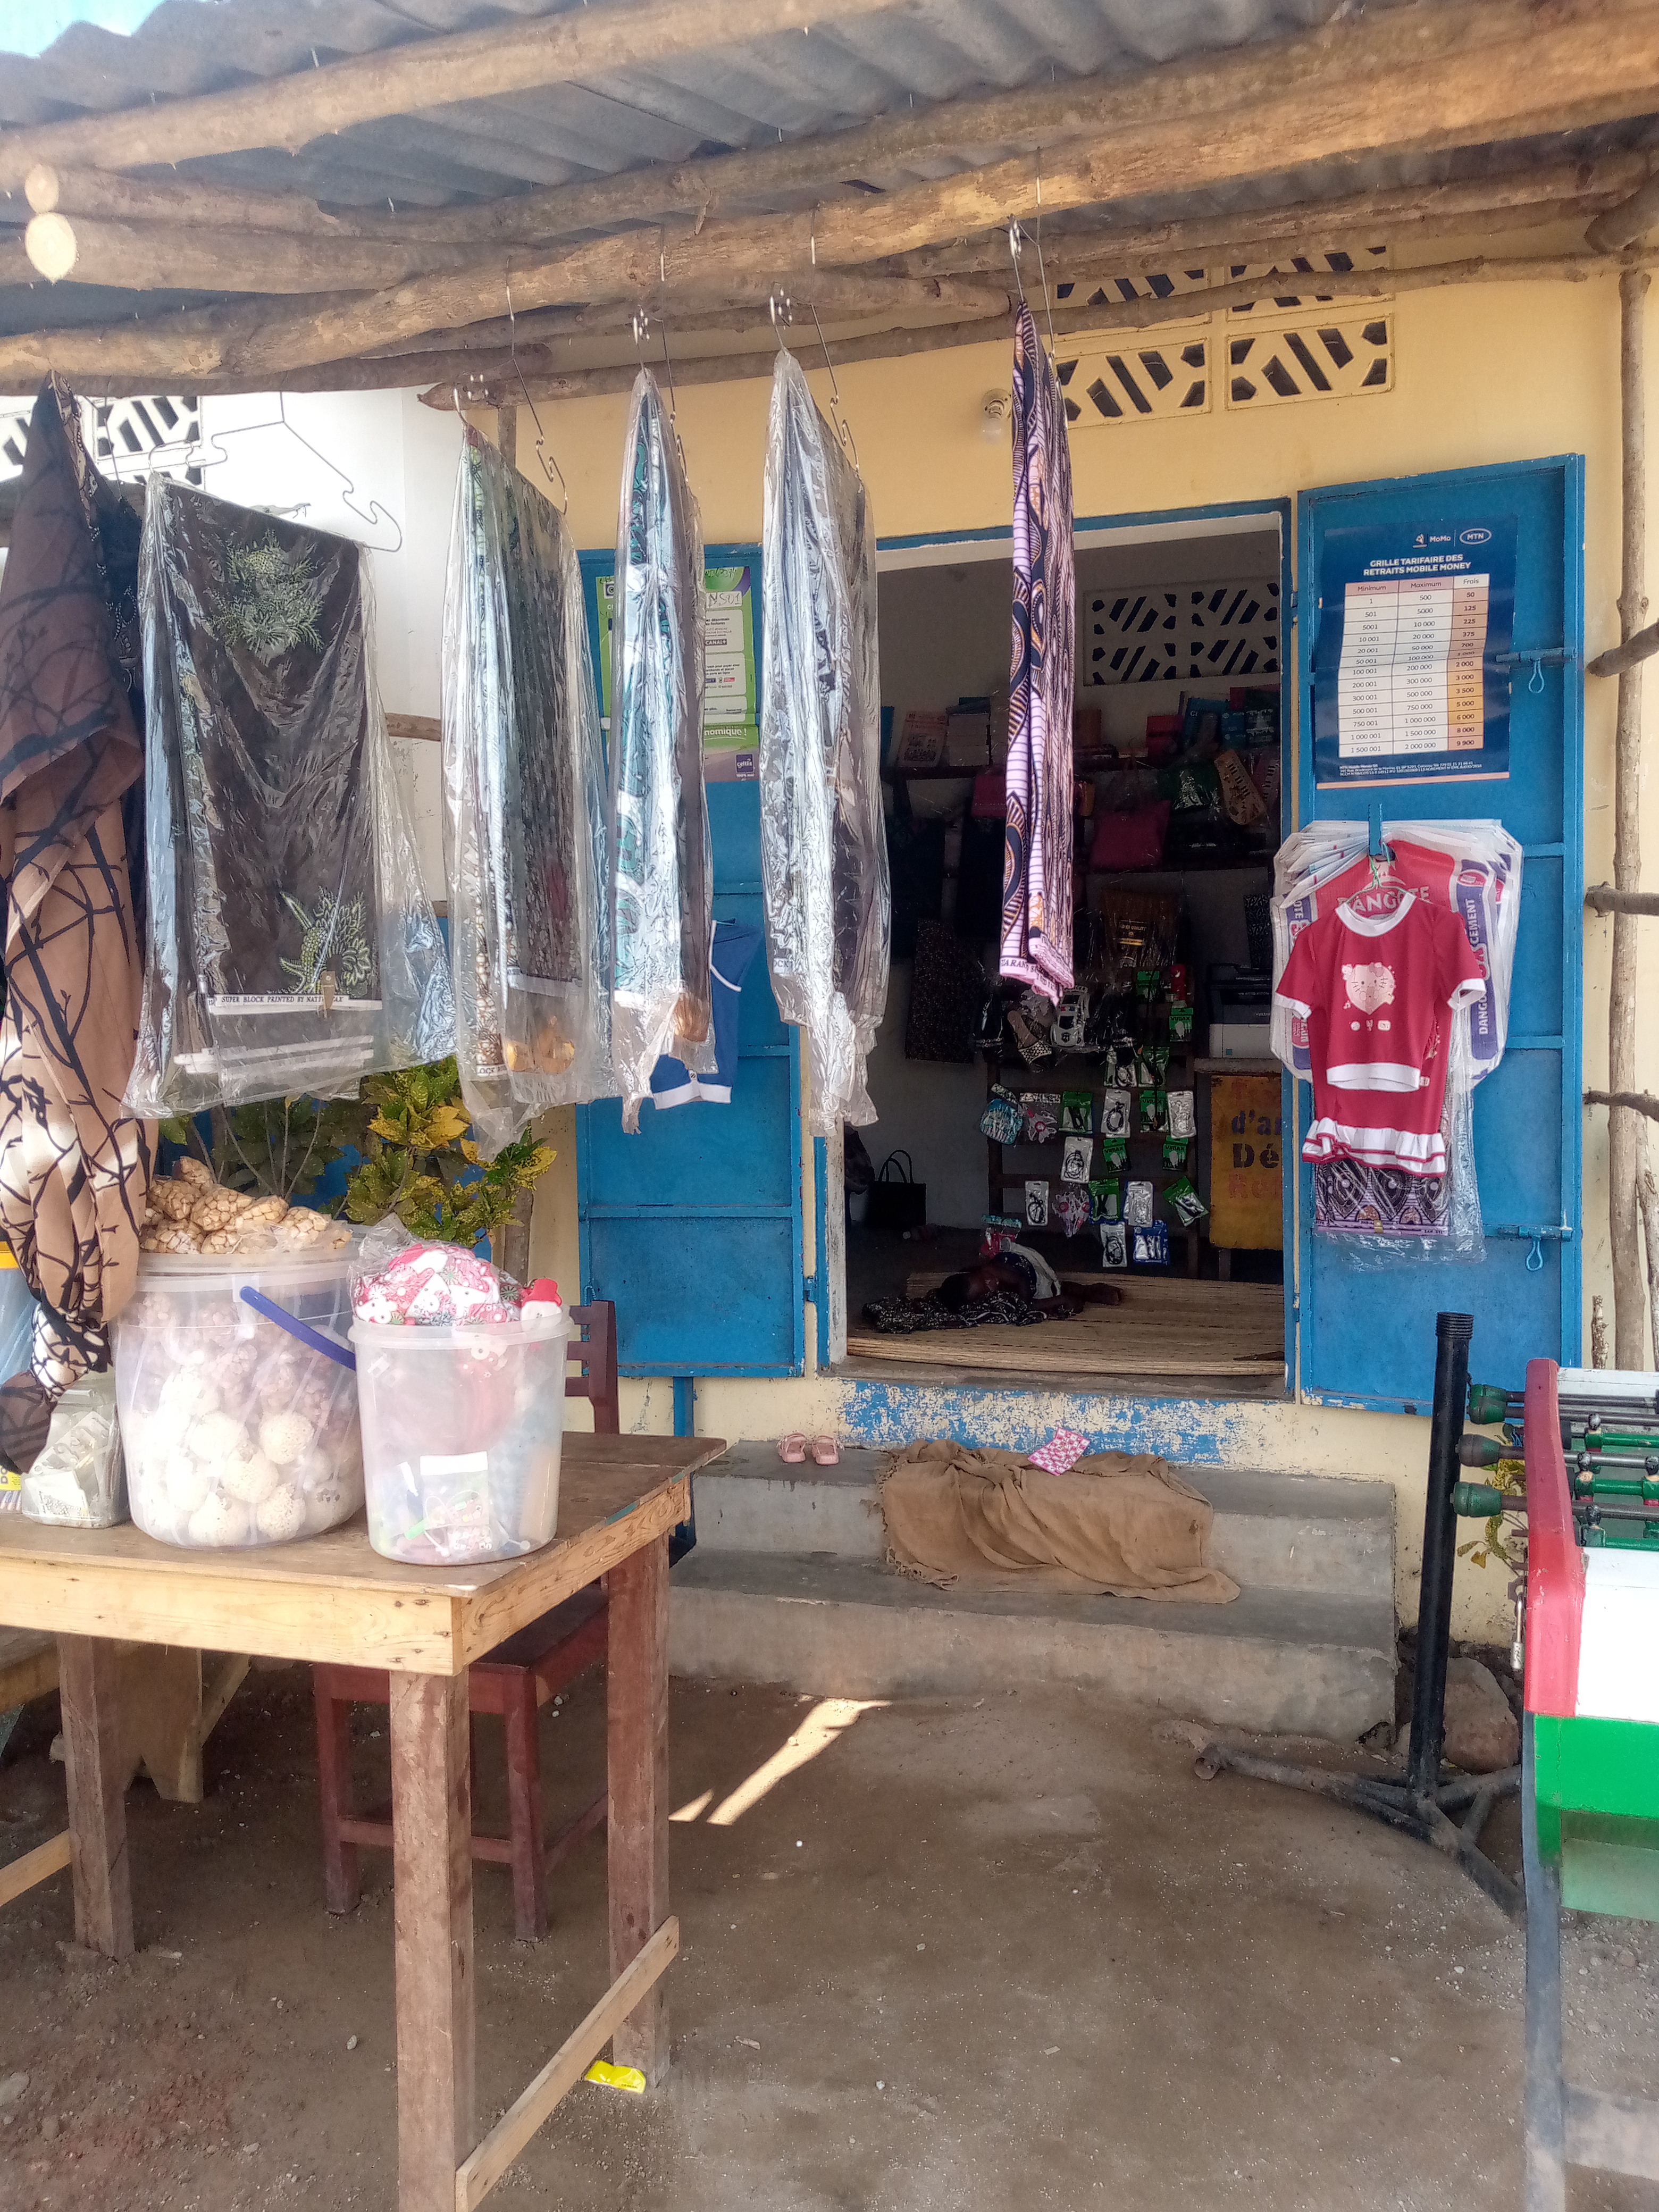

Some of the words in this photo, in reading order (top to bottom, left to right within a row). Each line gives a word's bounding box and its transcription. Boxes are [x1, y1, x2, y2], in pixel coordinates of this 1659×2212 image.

[1363, 567, 1404, 576] RETRAITS
[1406, 564, 1438, 573] MOBILE
[1439, 562, 1471, 571] MONEY
[1370, 559, 1400, 567] GRILLE
[1400, 556, 1444, 566] TARIFAIRE
[705, 726, 742, 736] nomique
[1465, 899, 1480, 945] CEMENT
[1478, 995, 1488, 1035] DANGO
[1233, 1143, 1280, 1169] Dé
